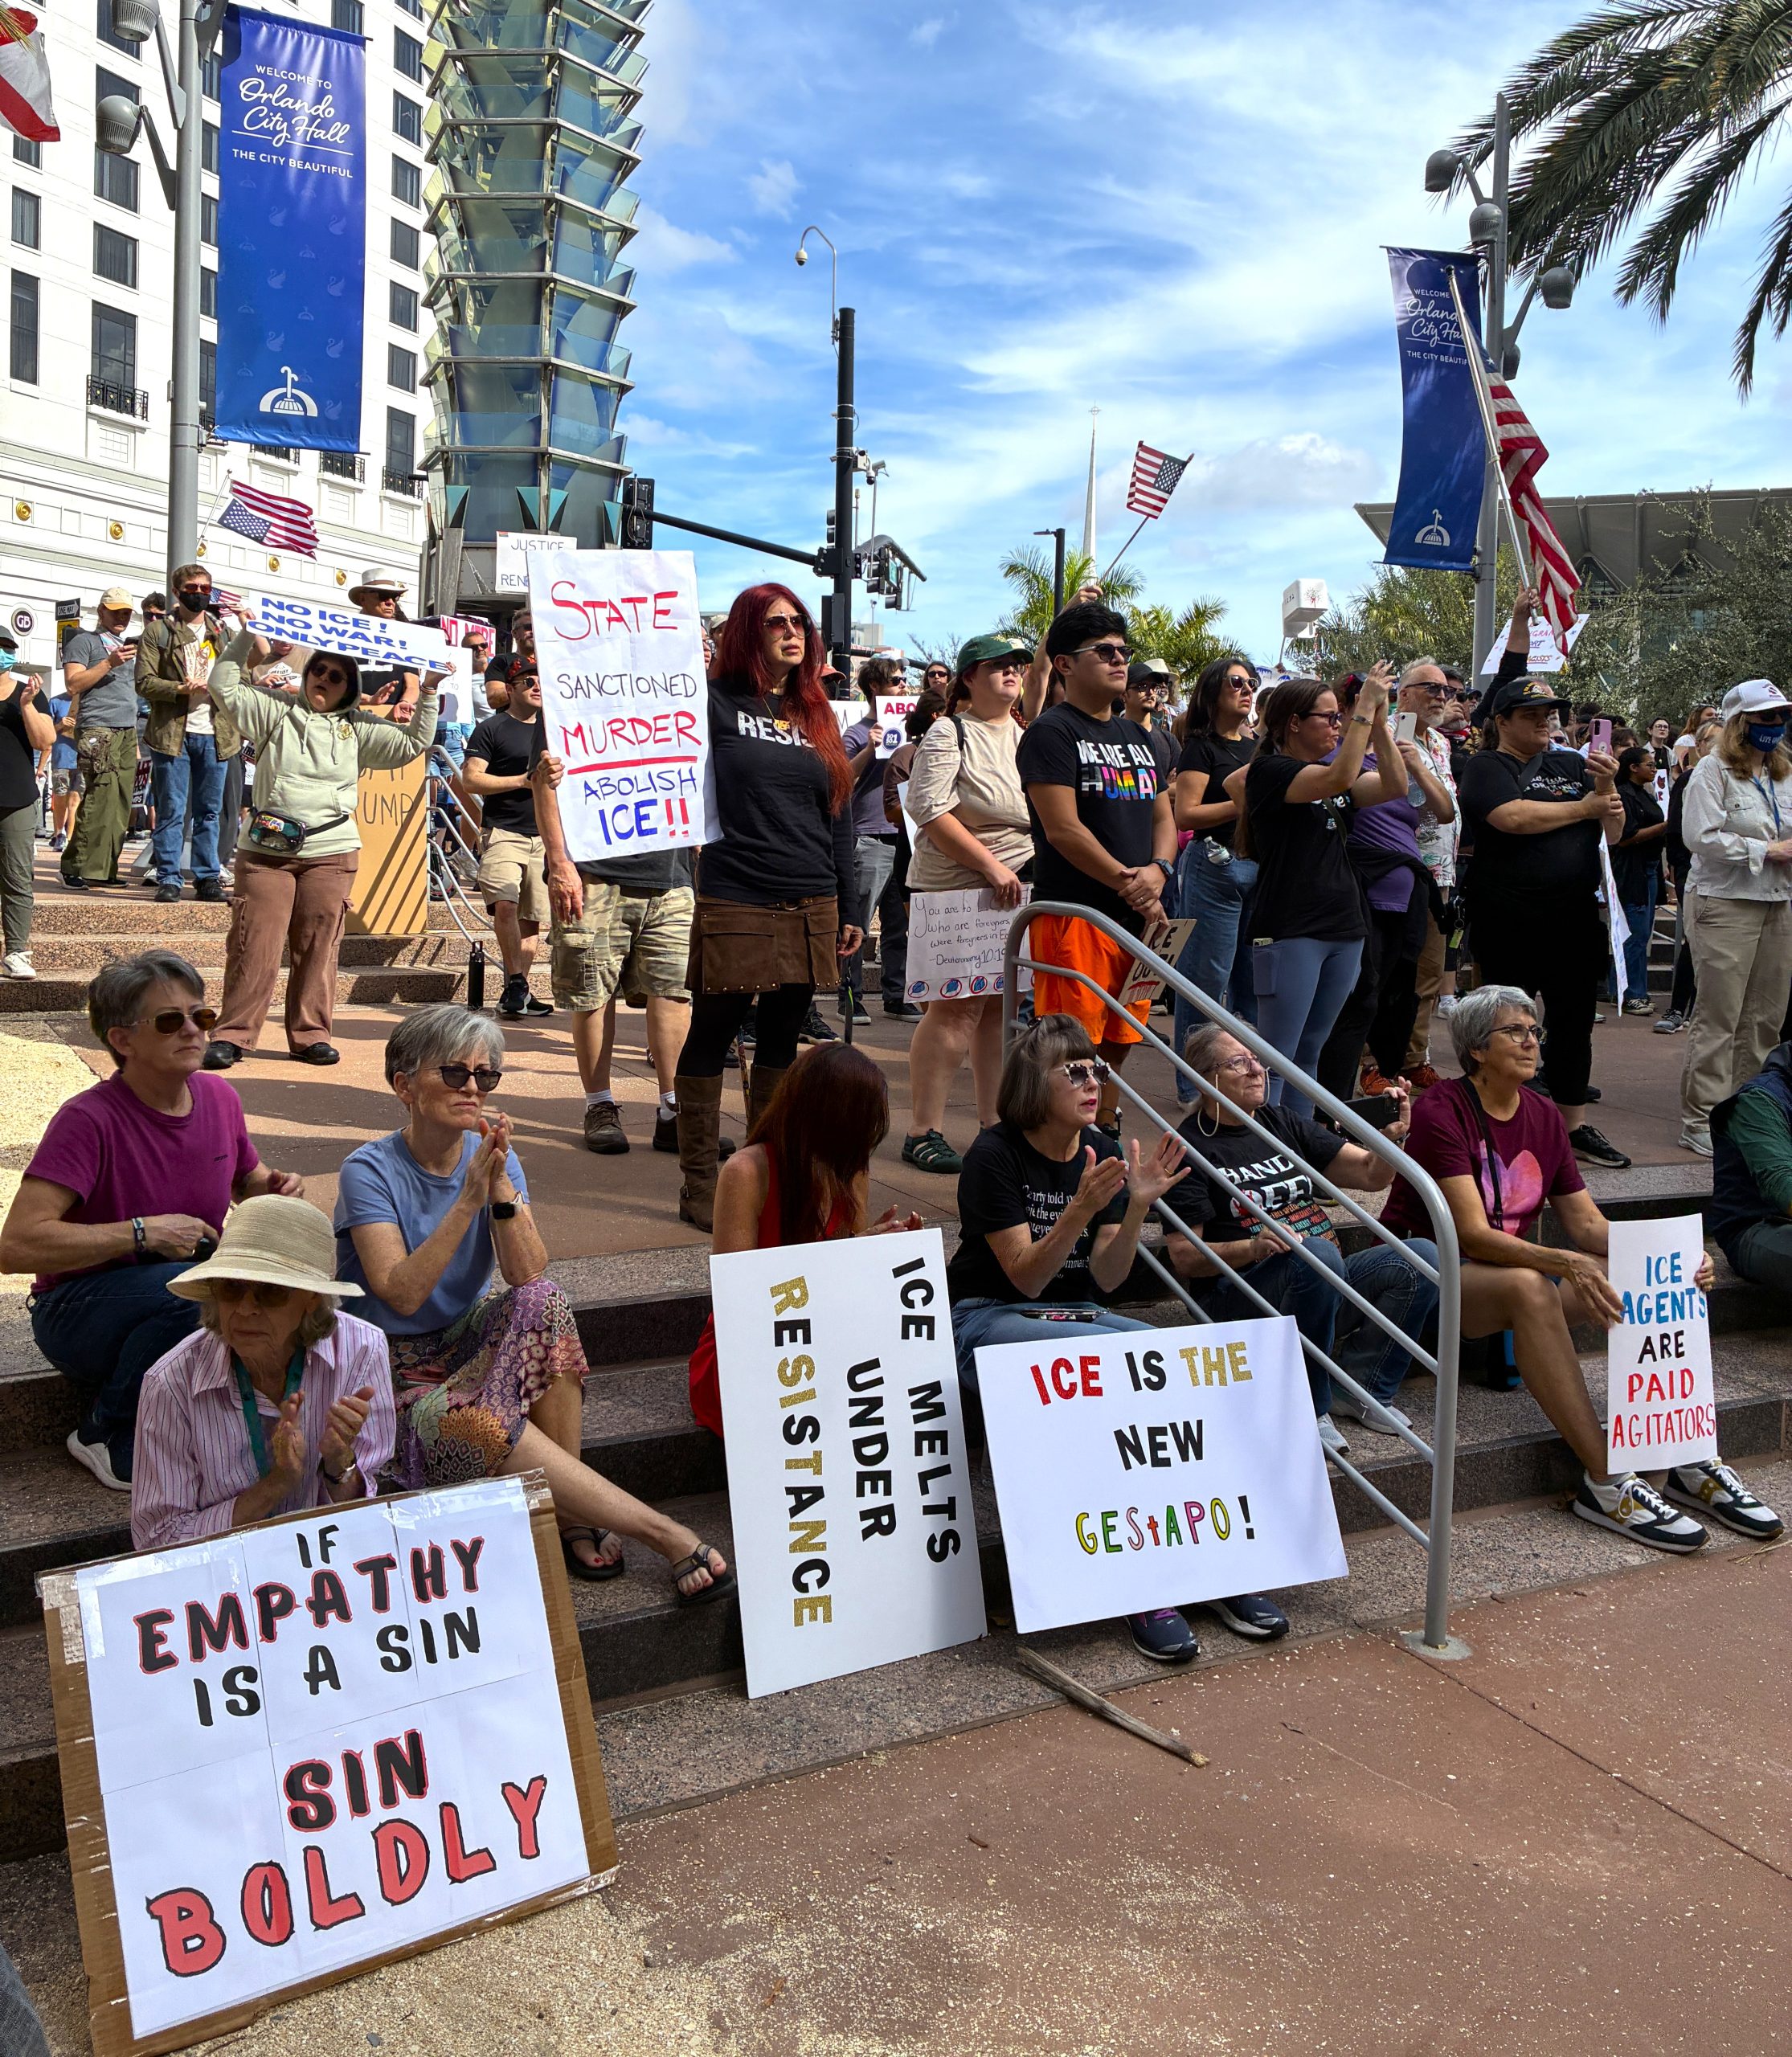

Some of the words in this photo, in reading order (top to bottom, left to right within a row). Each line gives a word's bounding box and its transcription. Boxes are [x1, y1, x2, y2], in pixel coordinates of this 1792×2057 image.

[256, 64, 313, 85] WELCOME
[317, 80, 332, 89] TO
[239, 78, 335, 118] Orlando
[243, 106, 290, 147] City
[292, 116, 350, 143] Hall
[232, 149, 256, 160] THE
[260, 153, 285, 166] CITY
[289, 159, 353, 178] BEAUTIFUL
[1406, 298, 1459, 321] Orland
[1414, 288, 1450, 298] WELCOME
[1412, 318, 1440, 347] City
[1439, 322, 1463, 341] Ha
[1440, 355, 1467, 365] BEAUTIF
[511, 538, 564, 551] JUSTICE
[16, 615, 31, 628] GB
[66, 605, 74, 614] WAY
[261, 597, 311, 615] NO
[318, 610, 370, 630] ICE
[261, 611, 312, 630] NO
[551, 581, 678, 640] STATE
[248, 621, 334, 648] ONLY
[338, 641, 449, 672] PEACE
[557, 672, 697, 699] SANCTIONED
[884, 702, 917, 714] ABO
[559, 710, 702, 758] MURDER
[737, 710, 816, 748] RESI
[1076, 740, 1104, 764] WE
[1098, 743, 1131, 768] ARE
[583, 766, 697, 806] ABOLISH
[354, 791, 414, 827] UMP
[914, 898, 940, 939] You
[962, 902, 972, 913] to
[928, 920, 950, 934] who
[955, 922, 969, 931] are
[931, 939, 952, 948] were
[1217, 1154, 1295, 1184] HAND
[1037, 1206, 1049, 1220] the
[1047, 1192, 1064, 1204] told
[1647, 1251, 1682, 1287] ICE
[892, 1257, 935, 1341] ICE
[1621, 1287, 1706, 1326] AGENTS
[1638, 1330, 1685, 1364] ARE
[1030, 1356, 1103, 1406] ICE
[1125, 1350, 1166, 1392] IS
[1179, 1341, 1253, 1387] THE
[1627, 1368, 1695, 1404] PAID
[1611, 1402, 1716, 1450] AGITATORS
[769, 1275, 833, 1628] RESISTANCE
[846, 1358, 898, 1543] UNDER
[1113, 1419, 1204, 1470] NEW
[907, 1380, 961, 1564] MELTS
[297, 1523, 338, 1568] IF
[133, 1536, 484, 1675] EMPATHY
[194, 1666, 260, 1726] IS
[303, 1645, 341, 1695] A
[376, 1607, 481, 1673] SIN
[283, 1728, 429, 1832] SIN
[145, 1774, 546, 1977] BOLDLY
